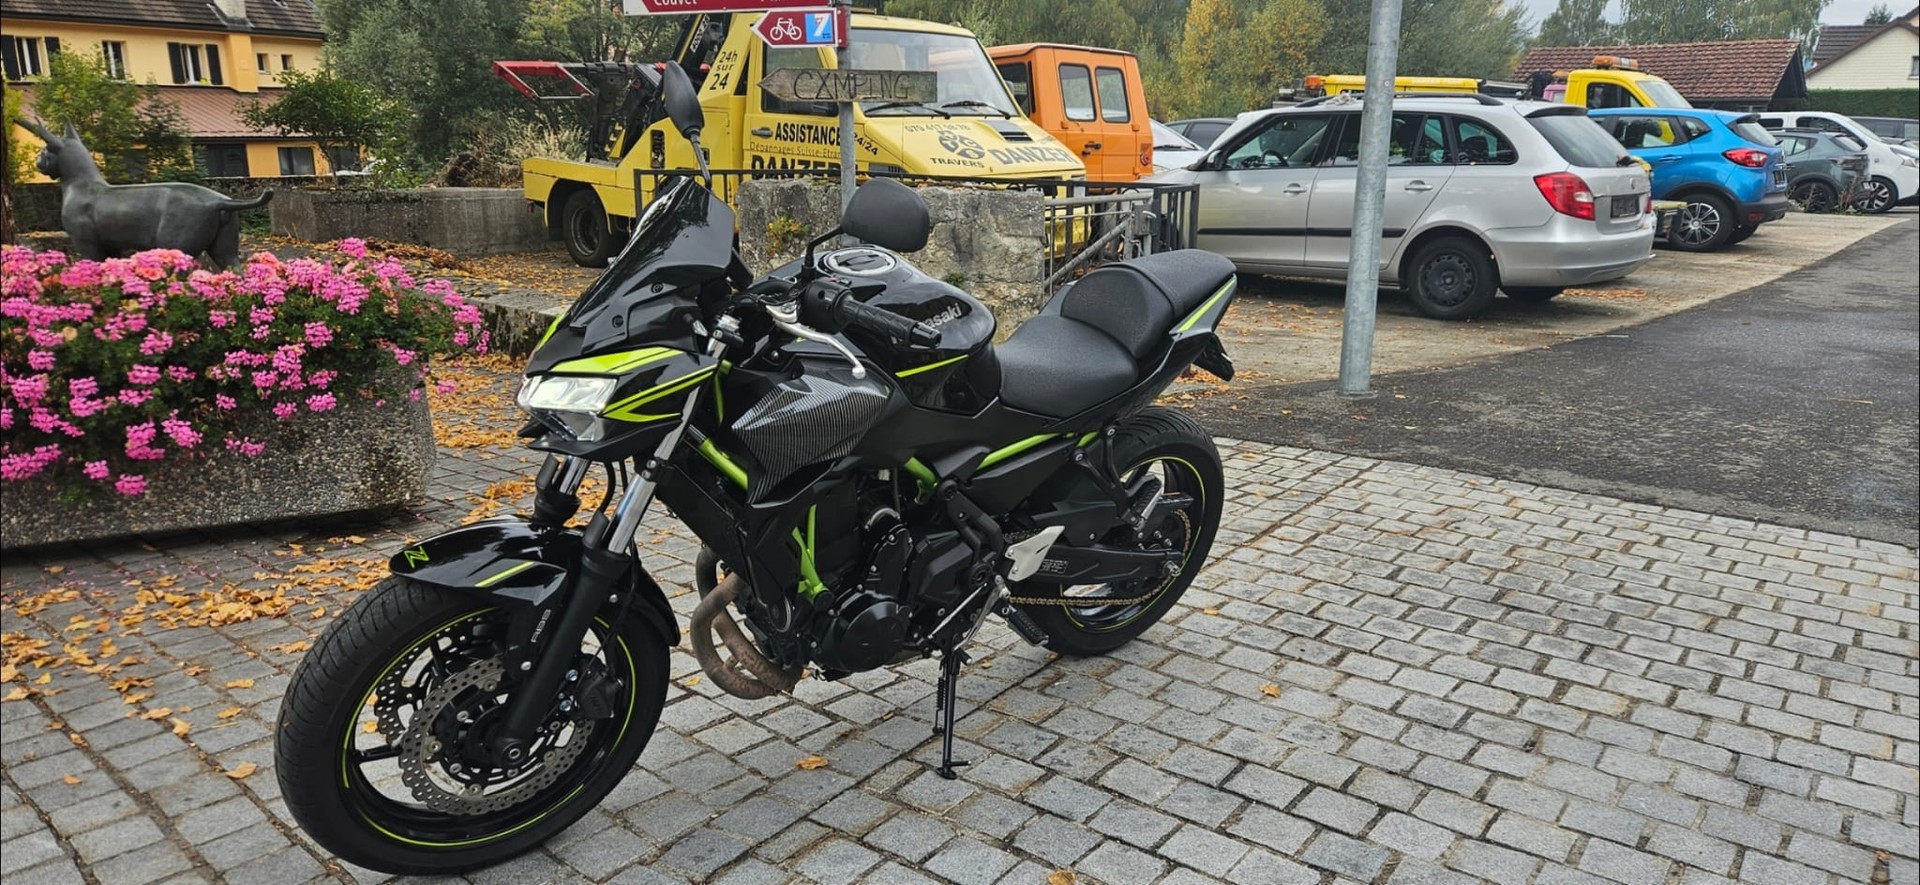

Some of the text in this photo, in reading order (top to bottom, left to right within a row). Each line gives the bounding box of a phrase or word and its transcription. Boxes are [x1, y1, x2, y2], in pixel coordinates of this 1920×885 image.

[814, 13, 831, 36] 7
[719, 50, 738, 63] 24h
[709, 72, 730, 90] 24
[930, 157, 985, 169] TRAVERS
[987, 146, 1080, 165] DANZER
[530, 609, 552, 643] ABS
